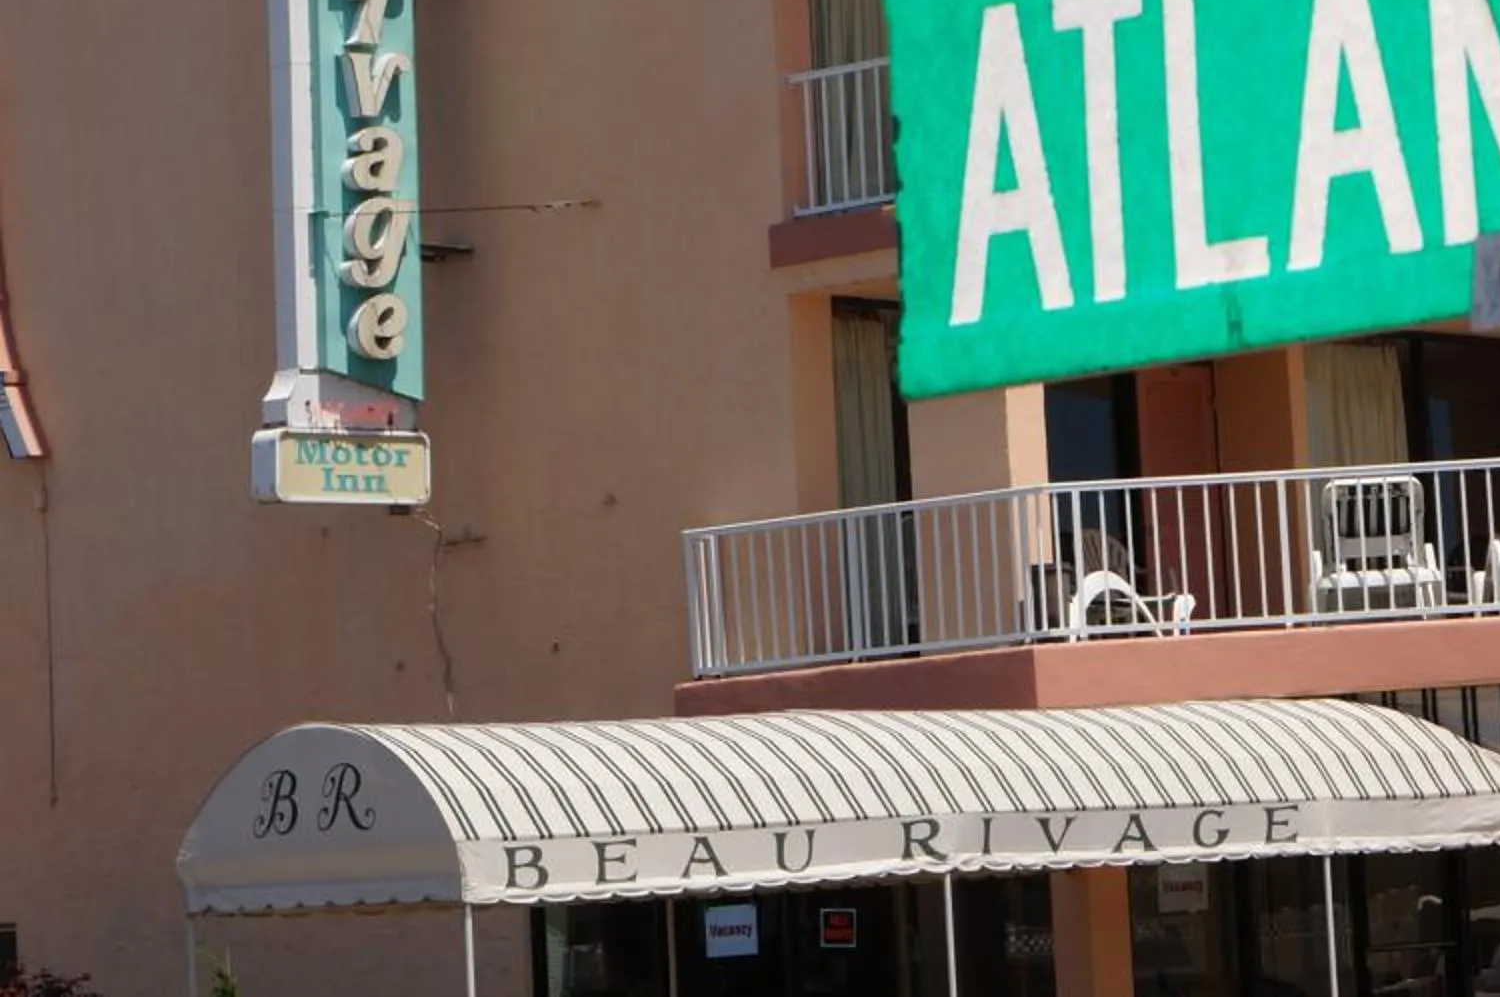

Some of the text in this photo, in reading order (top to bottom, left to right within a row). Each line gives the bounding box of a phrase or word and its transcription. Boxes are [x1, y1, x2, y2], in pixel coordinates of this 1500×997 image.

[295, 437, 410, 467] Motor
[321, 467, 390, 493] Inn
[253, 762, 376, 839] B R
[504, 805, 1301, 889] BEAU RIVAGE
